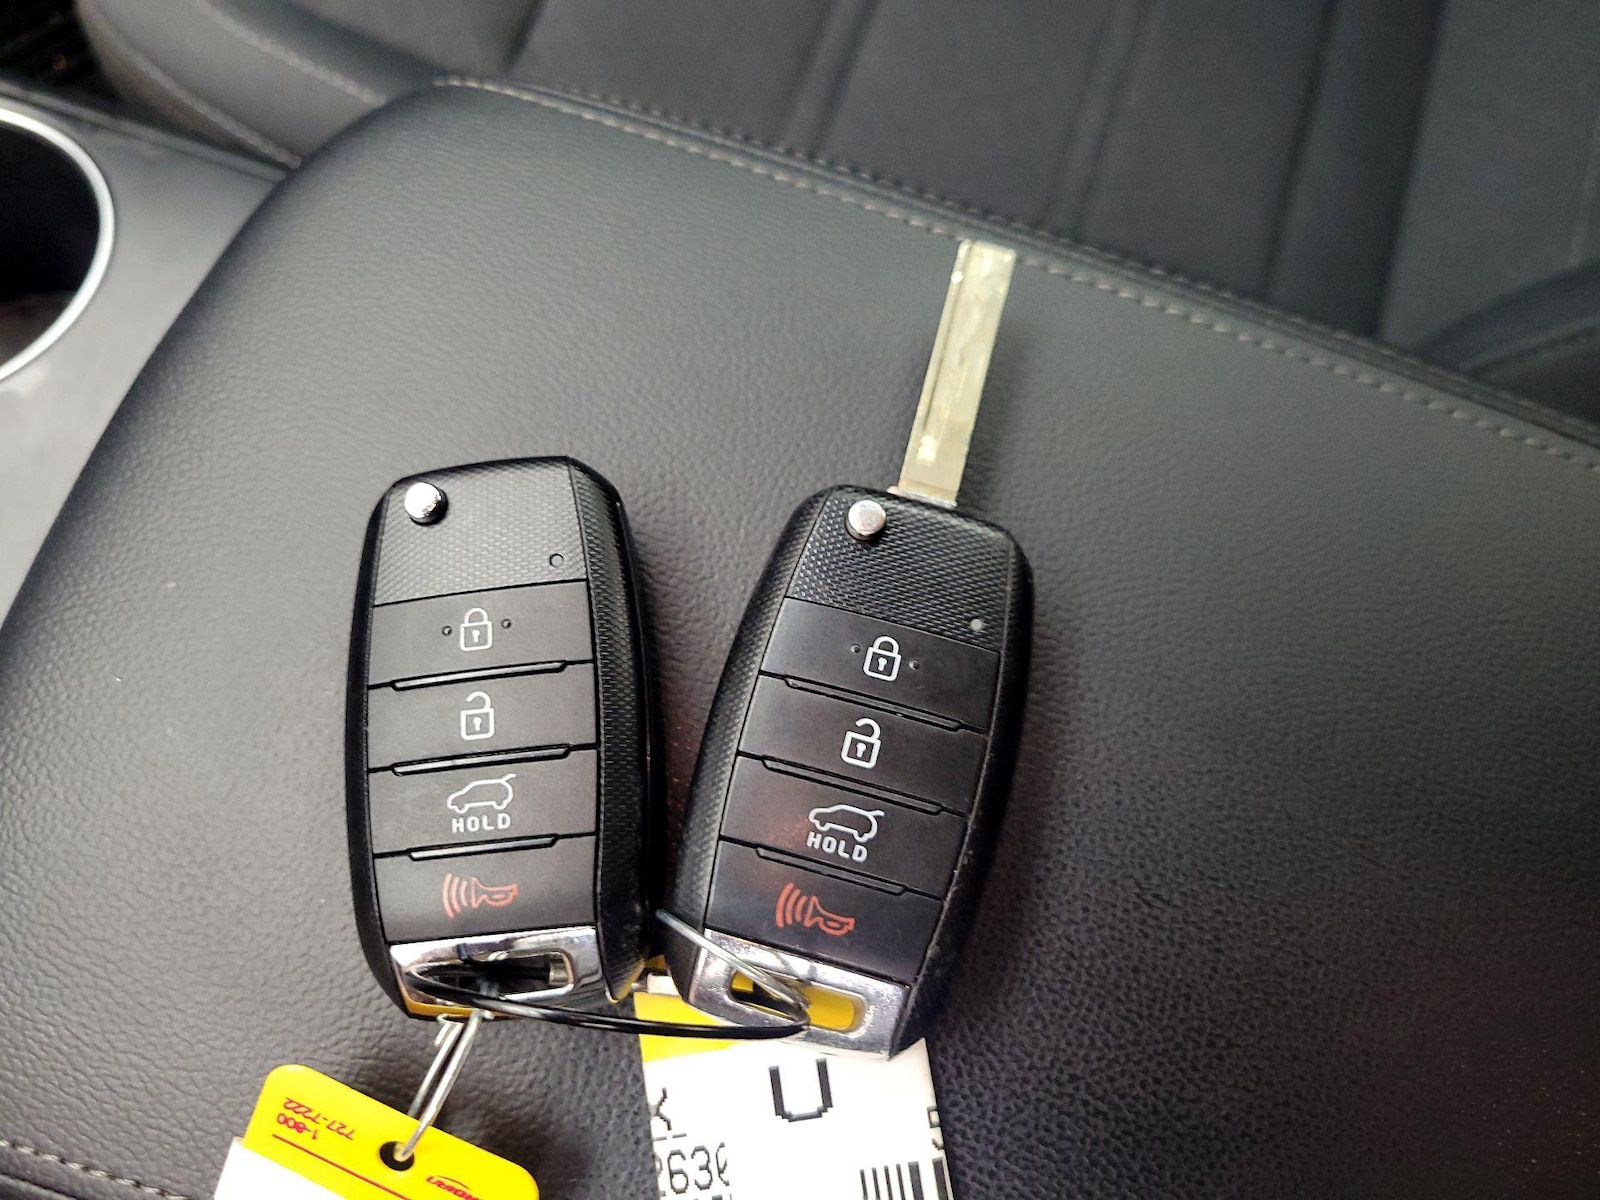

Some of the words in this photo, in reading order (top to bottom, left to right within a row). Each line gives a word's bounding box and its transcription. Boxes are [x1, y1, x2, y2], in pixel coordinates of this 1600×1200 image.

[451, 813, 511, 833] HOLD
[806, 831, 868, 862] HOLD
[769, 1058, 833, 1122] U
[277, 1113, 317, 1139] 1-800
[284, 1097, 355, 1140] 727-7222
